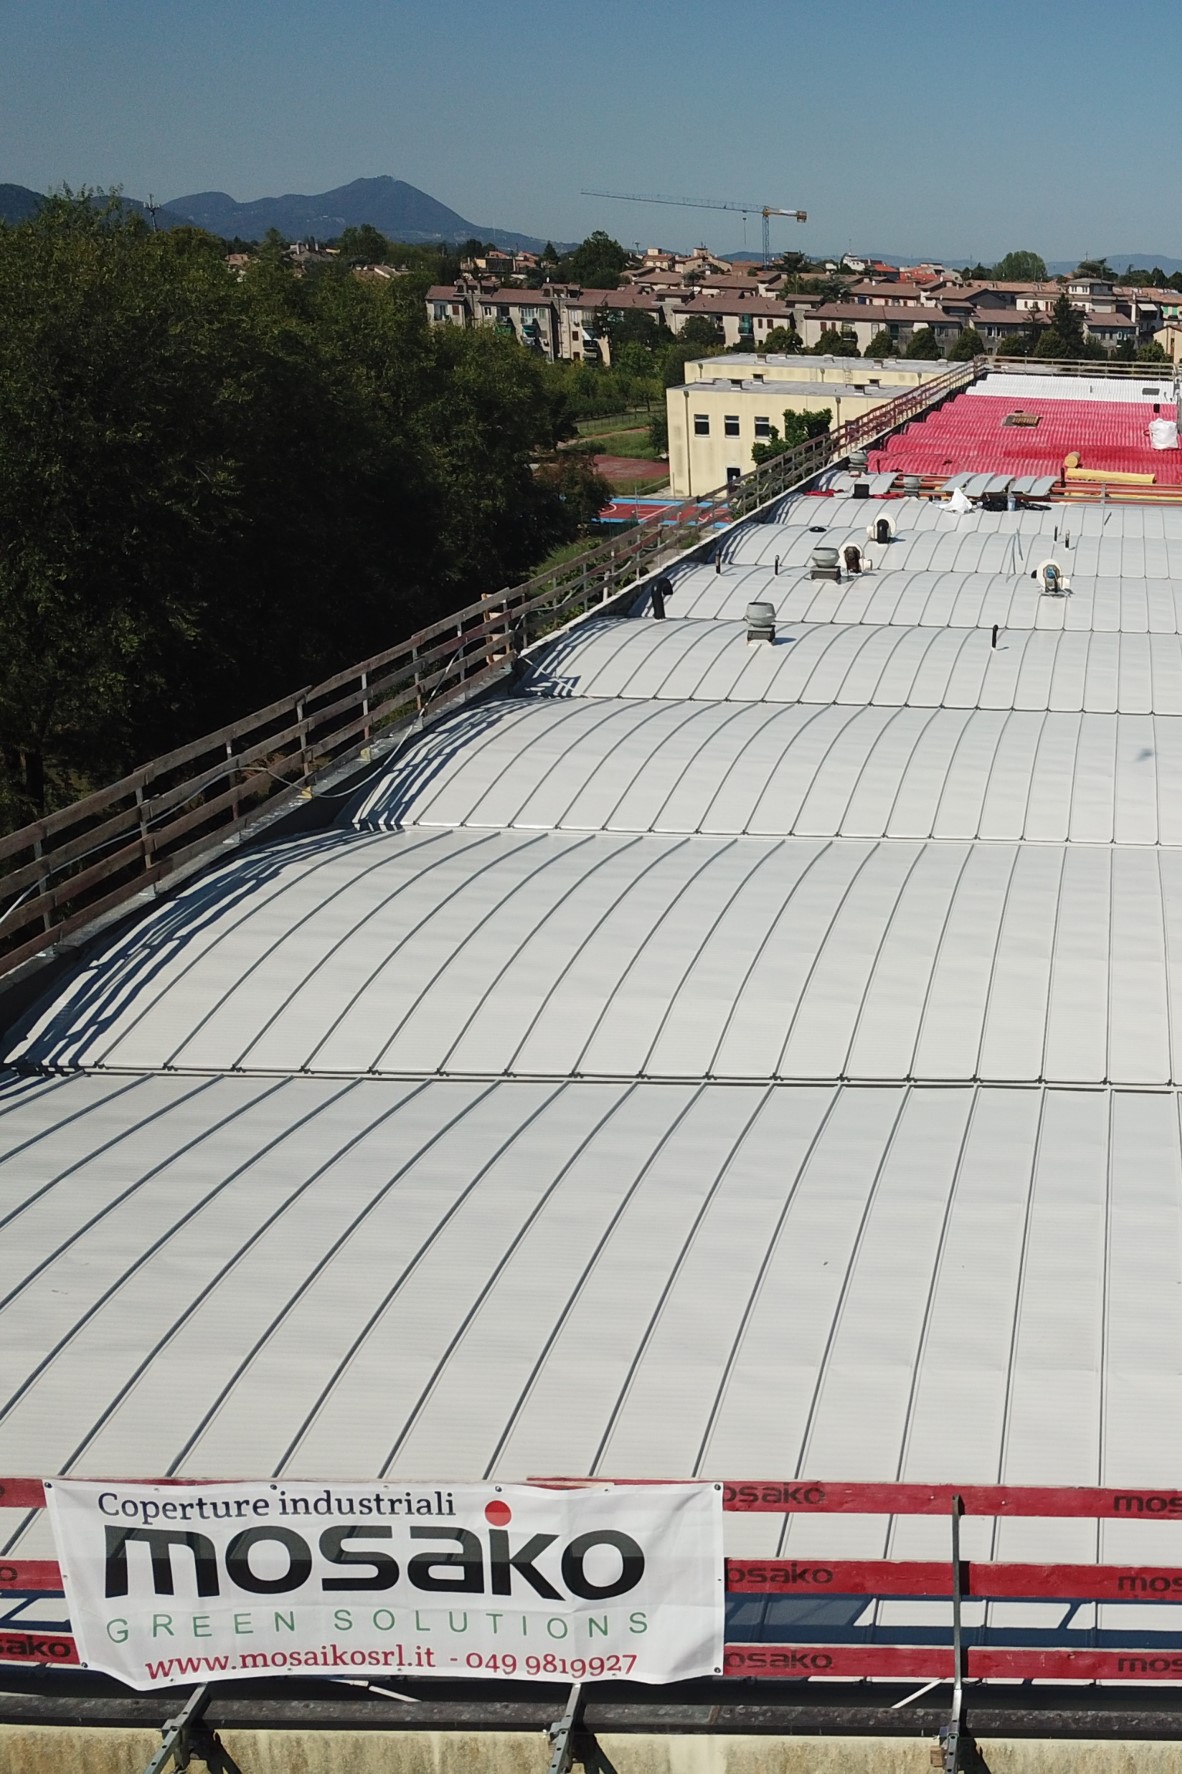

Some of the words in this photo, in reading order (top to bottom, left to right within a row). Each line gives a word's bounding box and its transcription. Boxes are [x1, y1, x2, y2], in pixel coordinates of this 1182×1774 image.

[98, 1492, 270, 1525] Coperture
[279, 1490, 456, 1516] industriali
[106, 1610, 295, 1643] GREEN
[333, 1609, 648, 1639] SOLUTIONS
[145, 1644, 436, 1679] www.mosaikosrl.it
[465, 1651, 517, 1674] 049
[525, 1653, 638, 1678] 9819927
